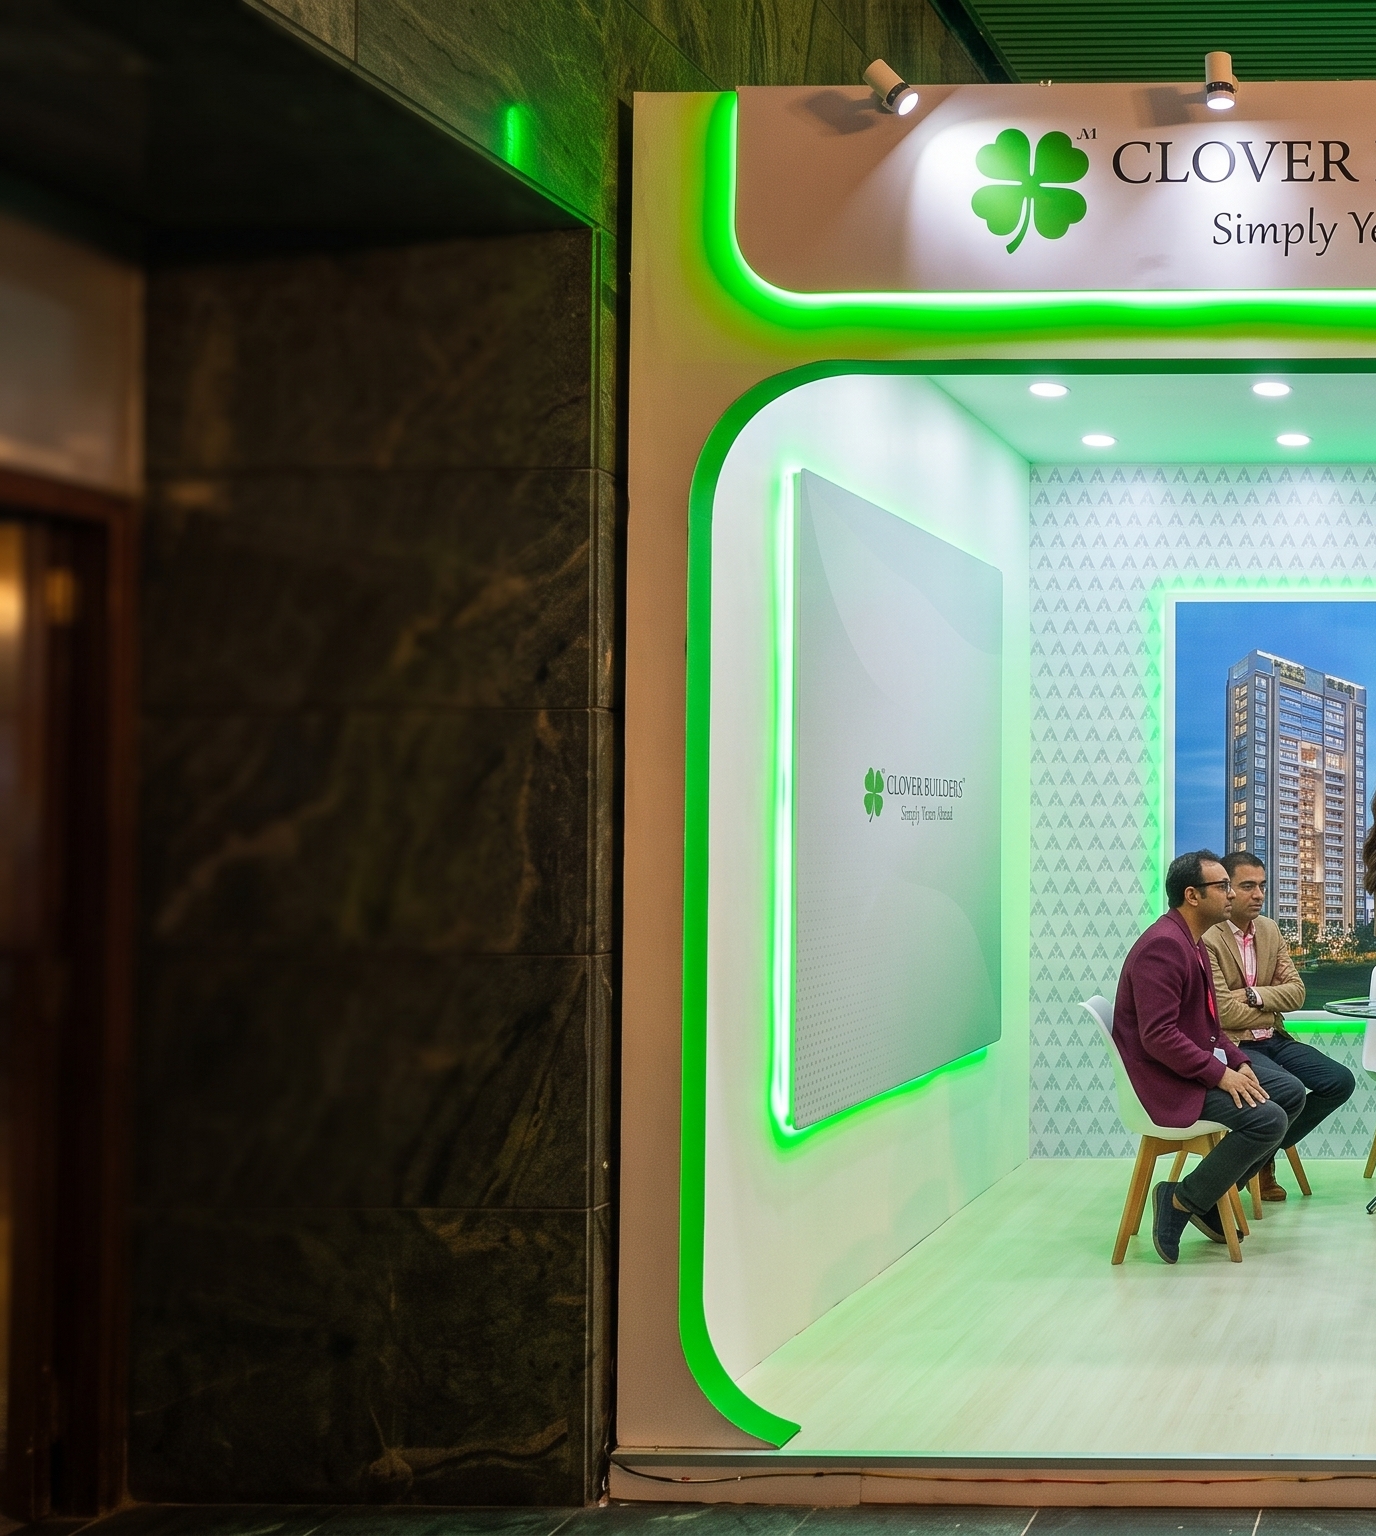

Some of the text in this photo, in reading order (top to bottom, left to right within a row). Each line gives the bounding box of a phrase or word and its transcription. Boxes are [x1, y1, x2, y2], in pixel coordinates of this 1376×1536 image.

[1111, 139, 1360, 184] CLOVER
[1212, 209, 1339, 257] Simply
[887, 775, 923, 796] CLOVER
